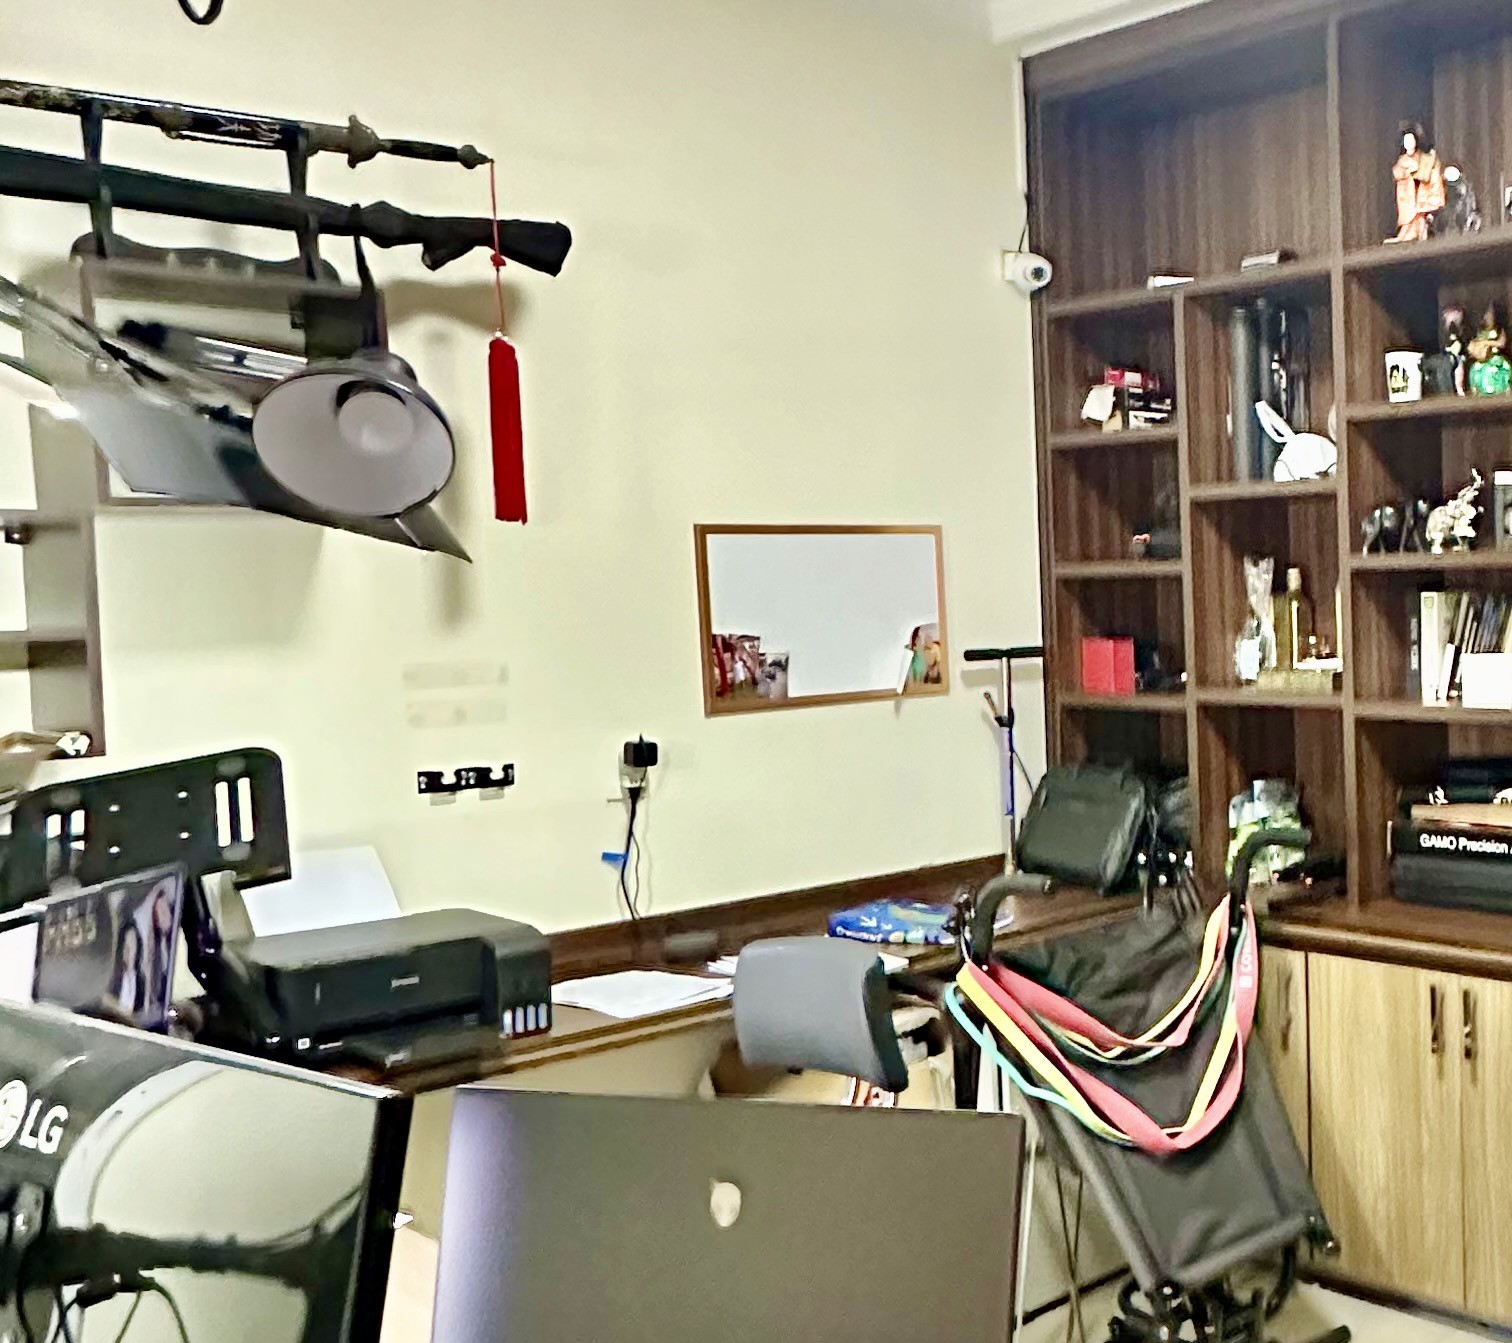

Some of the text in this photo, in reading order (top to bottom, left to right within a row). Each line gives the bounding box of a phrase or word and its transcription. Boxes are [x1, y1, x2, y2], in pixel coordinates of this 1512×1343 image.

[1420, 833, 1457, 851] GAMO
[1458, 836, 1509, 855] Precision
[19, 1097, 69, 1155] LG
